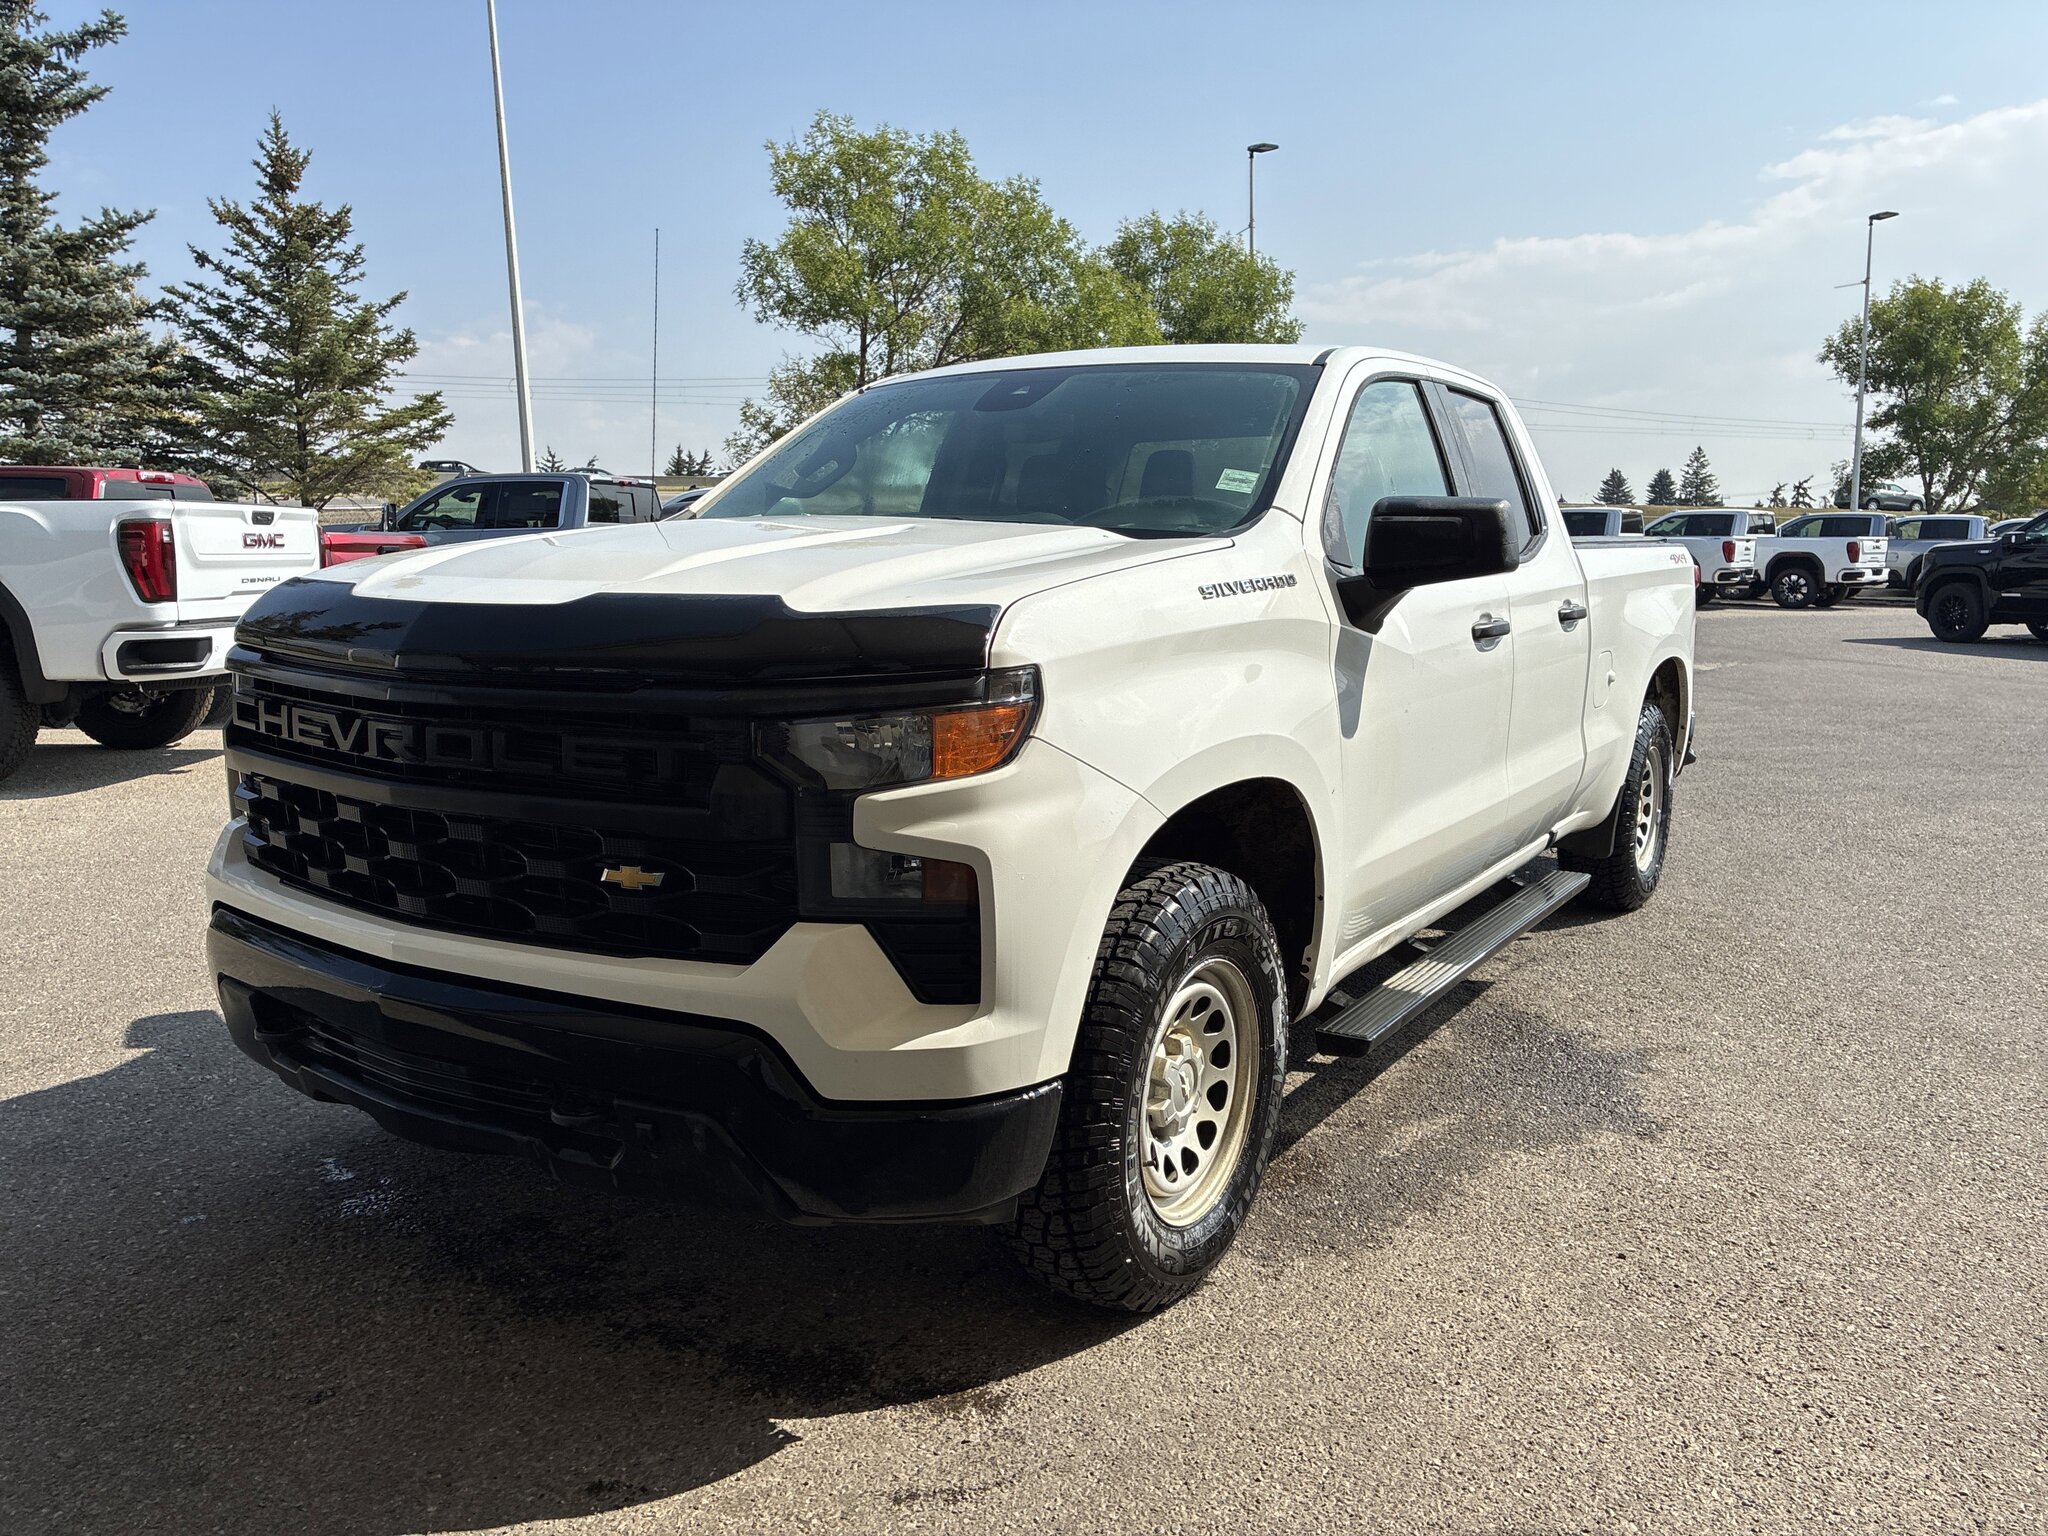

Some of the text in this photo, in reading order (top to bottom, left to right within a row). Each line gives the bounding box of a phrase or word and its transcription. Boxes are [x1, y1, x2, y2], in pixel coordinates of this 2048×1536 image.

[242, 532, 286, 549] GMC
[241, 576, 281, 584] DENALI
[1198, 573, 1297, 600] SILVERADO
[232, 698, 706, 779] CHEVROLET
